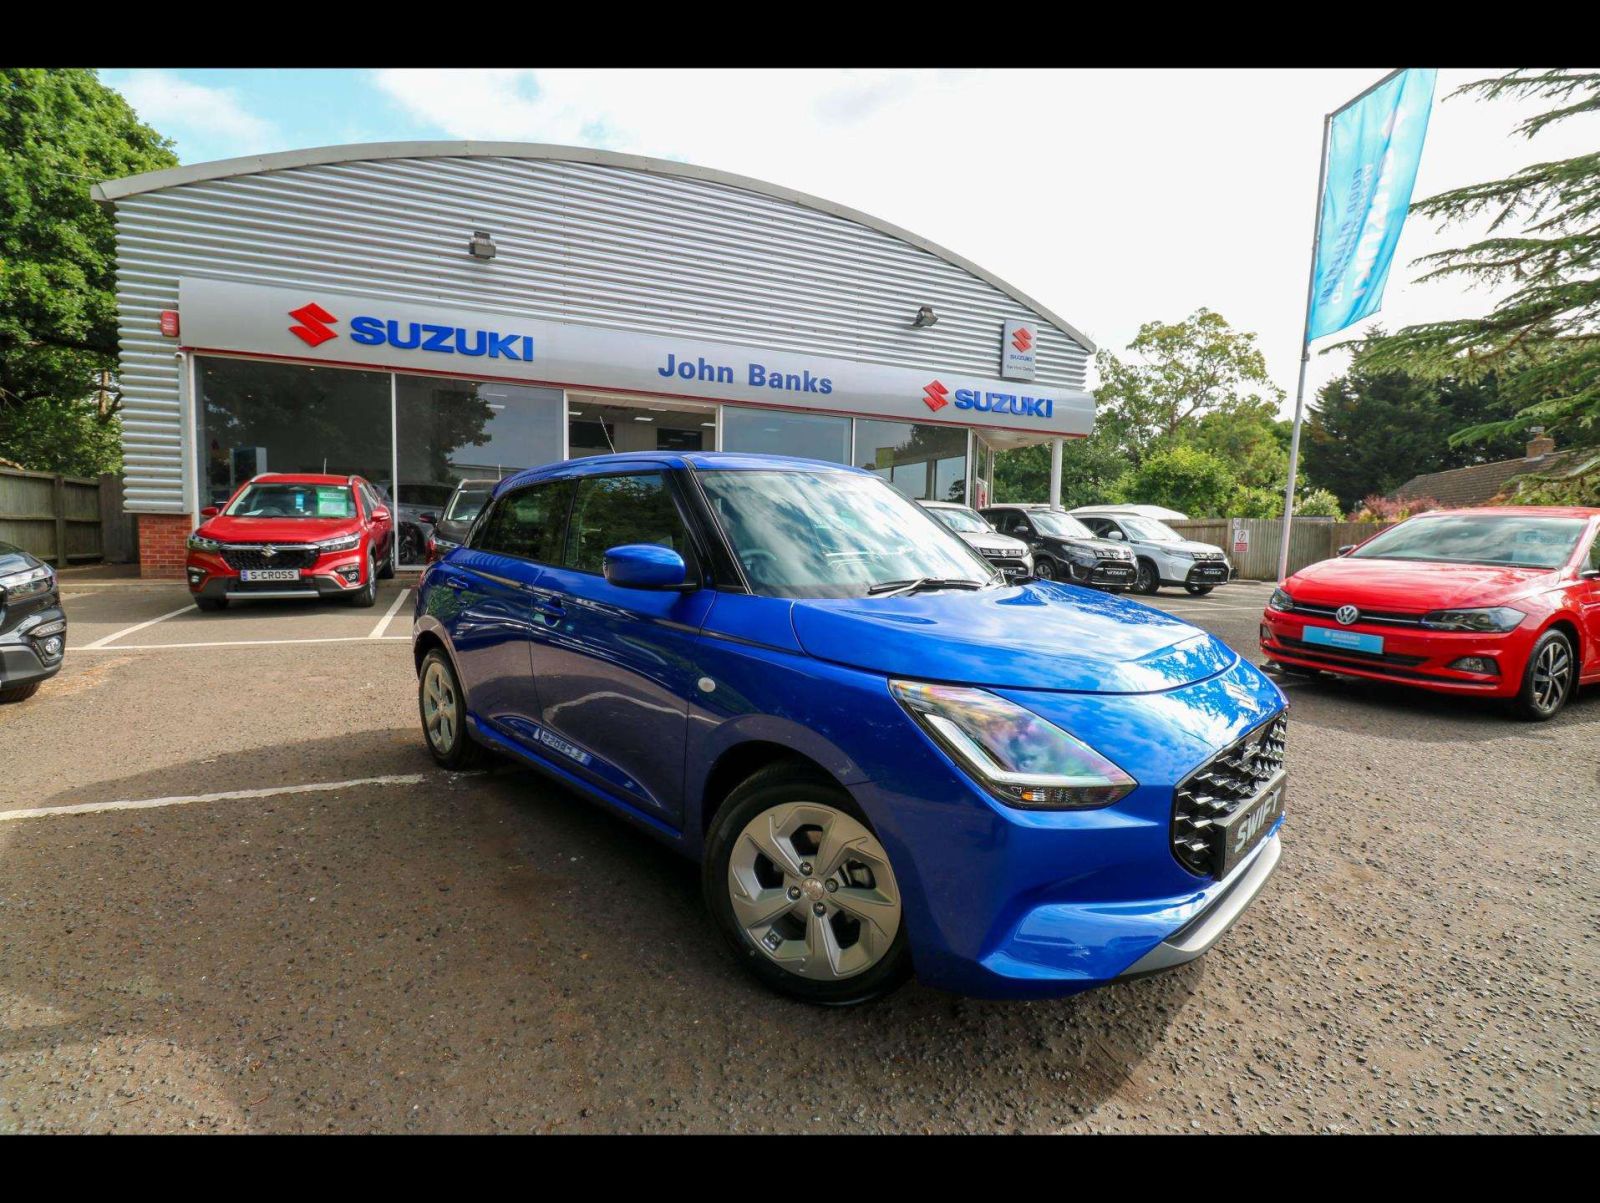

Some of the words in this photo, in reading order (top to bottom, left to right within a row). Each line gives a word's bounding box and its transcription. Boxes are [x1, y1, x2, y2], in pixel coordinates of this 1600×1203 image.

[350, 316, 534, 362] SUZUKI
[658, 353, 735, 384] John
[748, 363, 833, 395] Banks
[954, 389, 1053, 418] SUZUKI
[250, 571, 295, 579] S-CROSS
[1235, 787, 1281, 854] SWIFT
